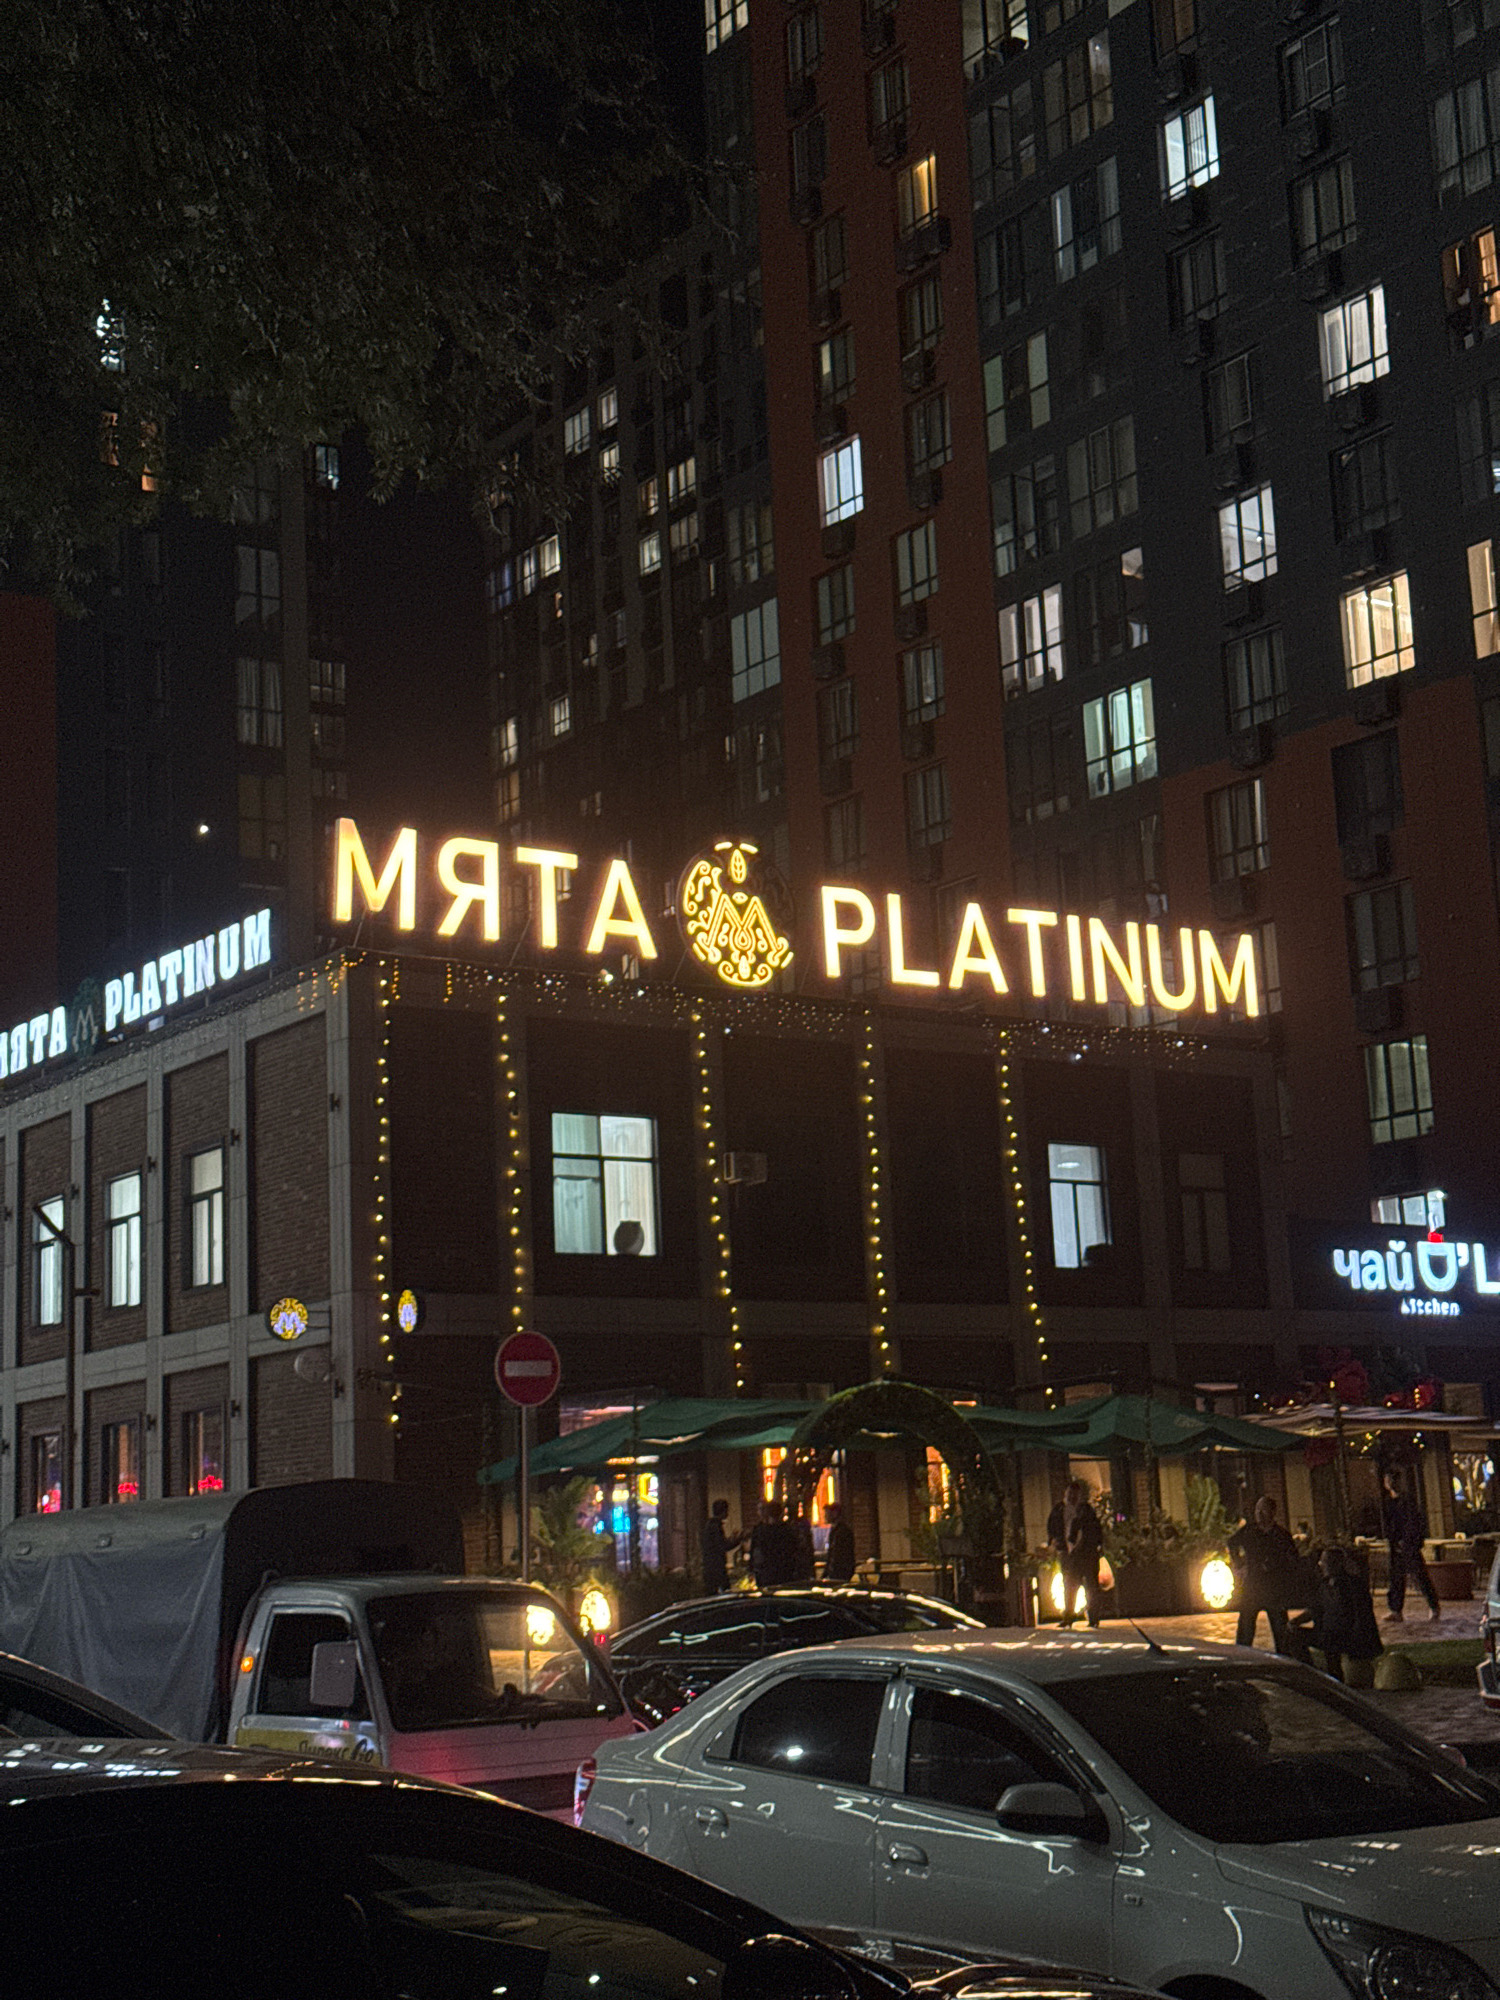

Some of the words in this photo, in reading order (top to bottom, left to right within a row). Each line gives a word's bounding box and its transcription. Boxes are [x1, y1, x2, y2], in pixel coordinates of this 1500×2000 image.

[333, 817, 657, 959] МЯТА
[821, 886, 1259, 1017] PLATINUM
[104, 908, 271, 1032] PLATINUM
